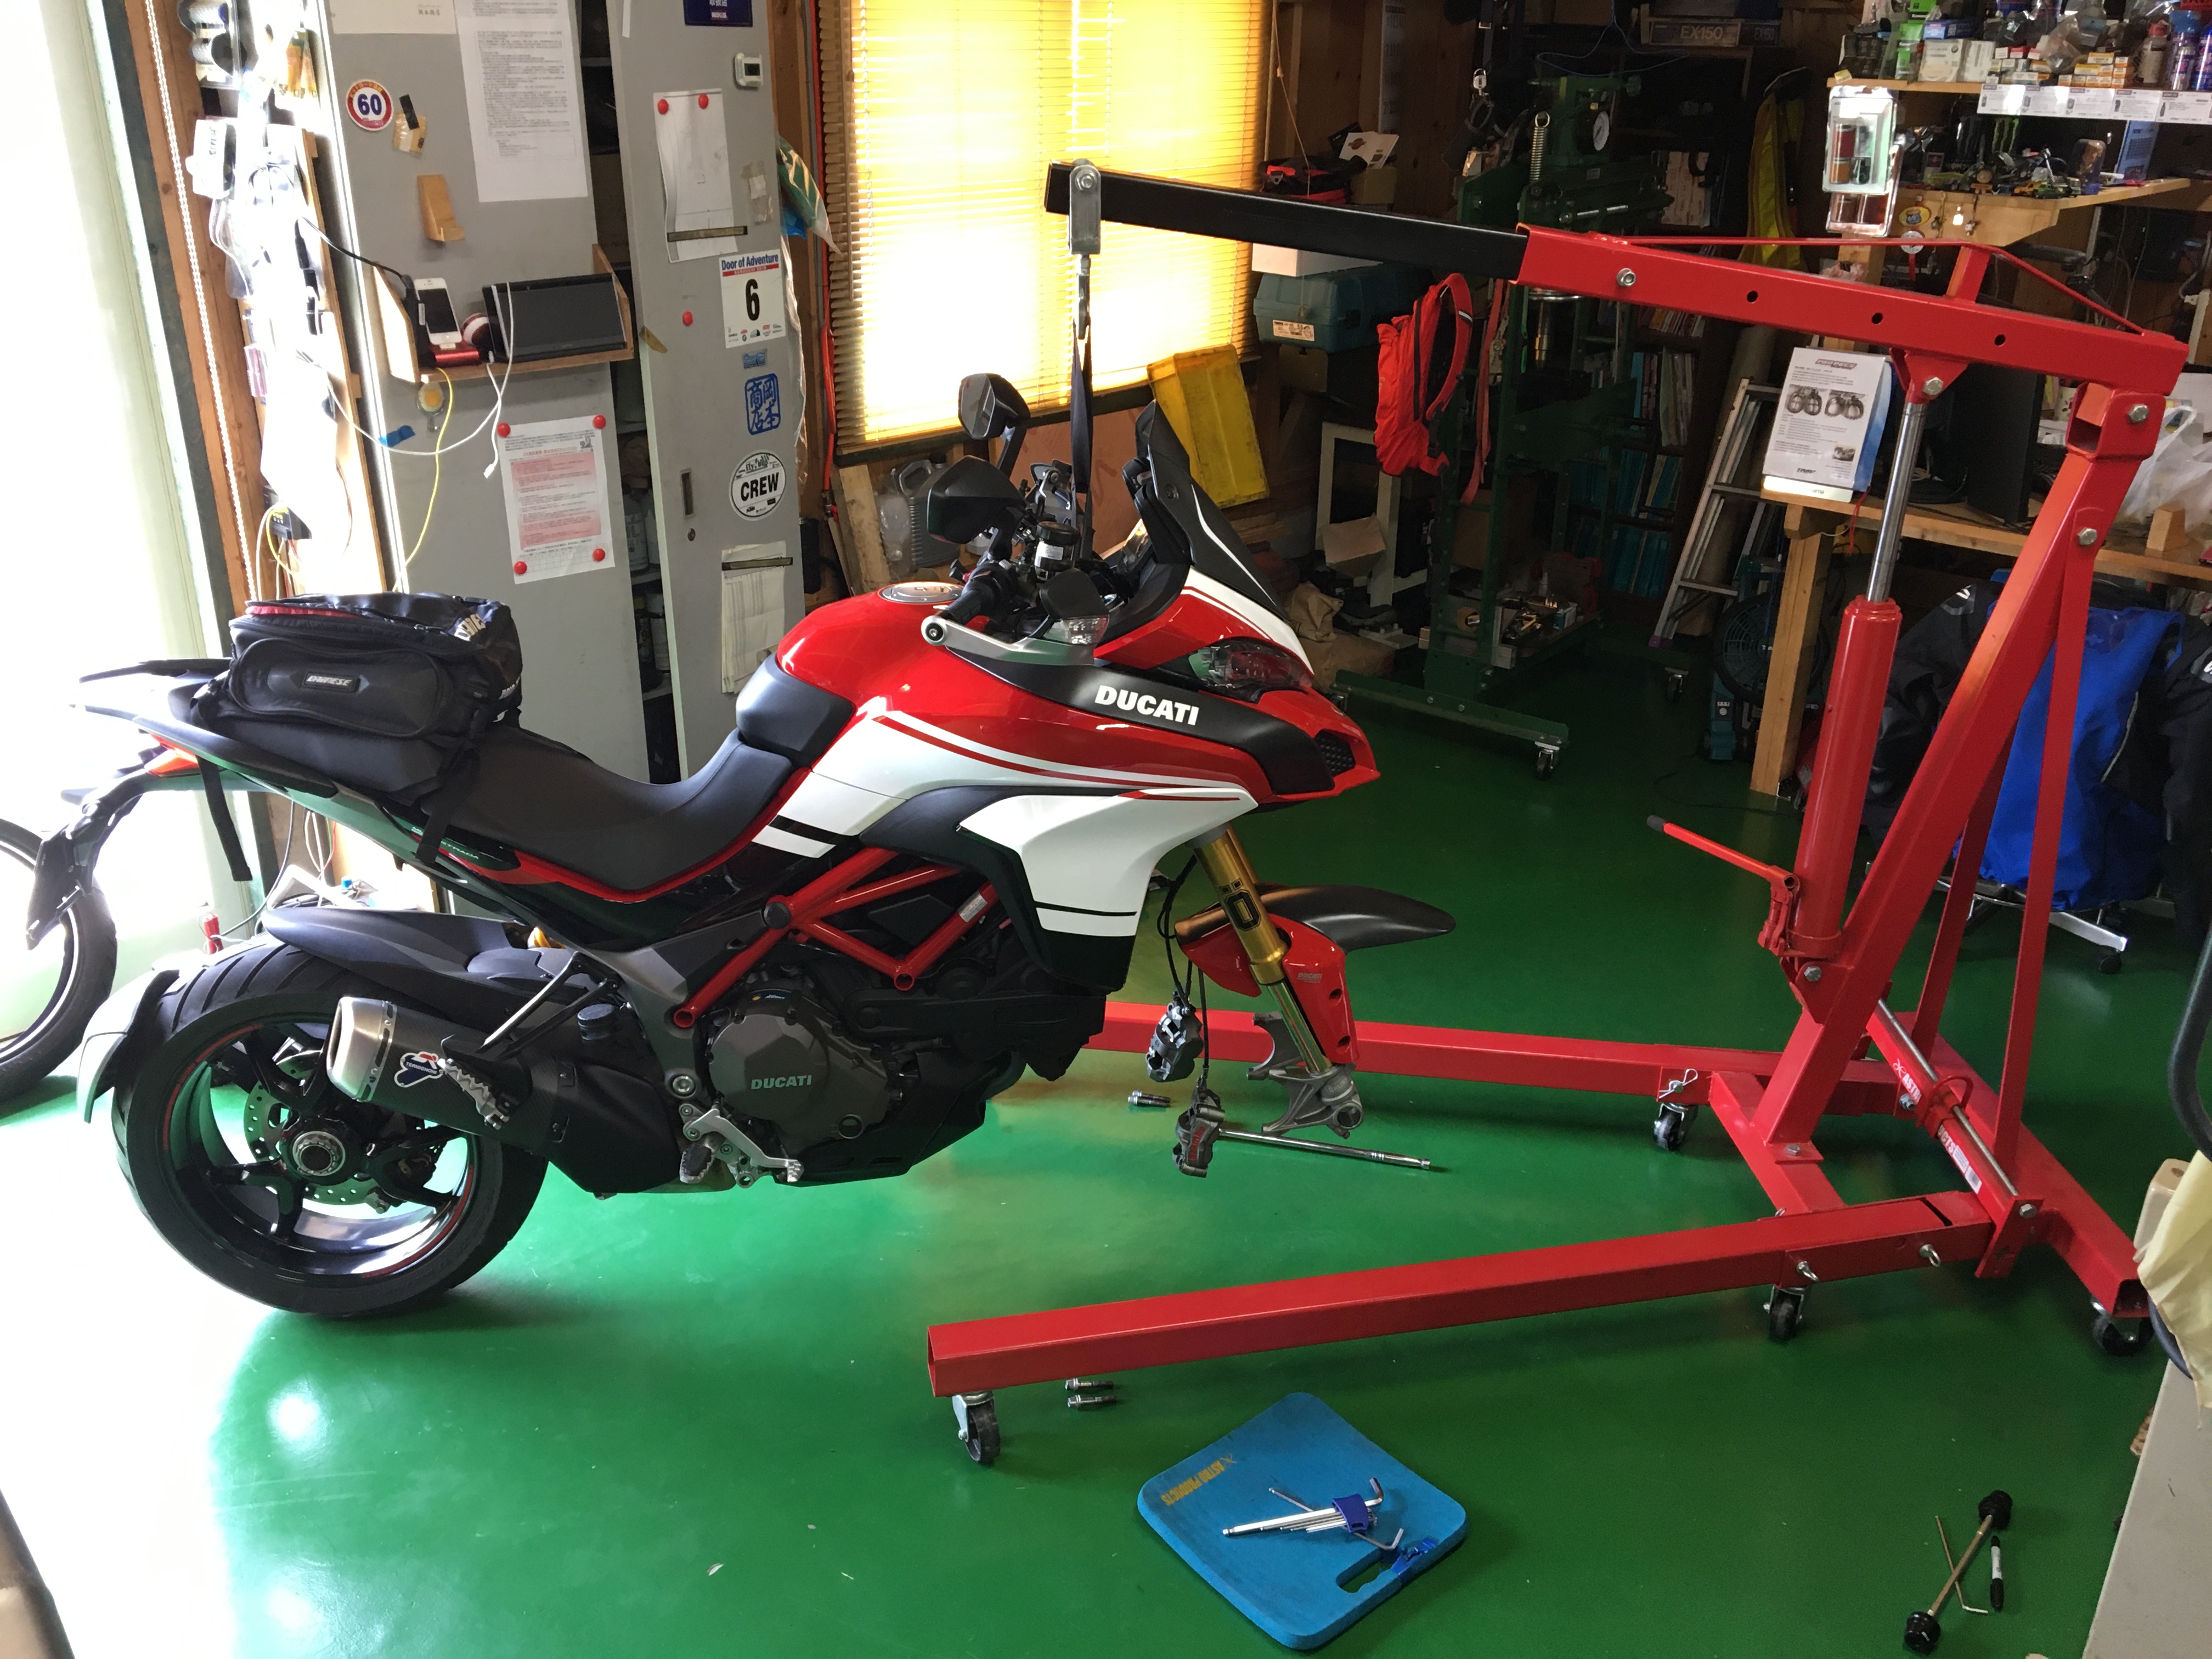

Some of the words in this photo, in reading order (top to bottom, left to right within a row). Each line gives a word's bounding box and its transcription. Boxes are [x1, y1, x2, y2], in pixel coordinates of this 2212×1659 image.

[357, 93, 382, 116] 60
[721, 259, 737, 270] Door
[738, 257, 745, 268] of
[746, 254, 778, 267] Adventure
[746, 279, 760, 321] 6
[741, 472, 779, 501] CREW
[1094, 685, 1199, 726] DUCATI
[406, 1062, 437, 1075] TERMIGNONI
[751, 1075, 812, 1090] DUCATI
[1198, 1460, 1225, 1483] ASTRO
[1161, 1475, 1203, 1506] PRODUCTS
